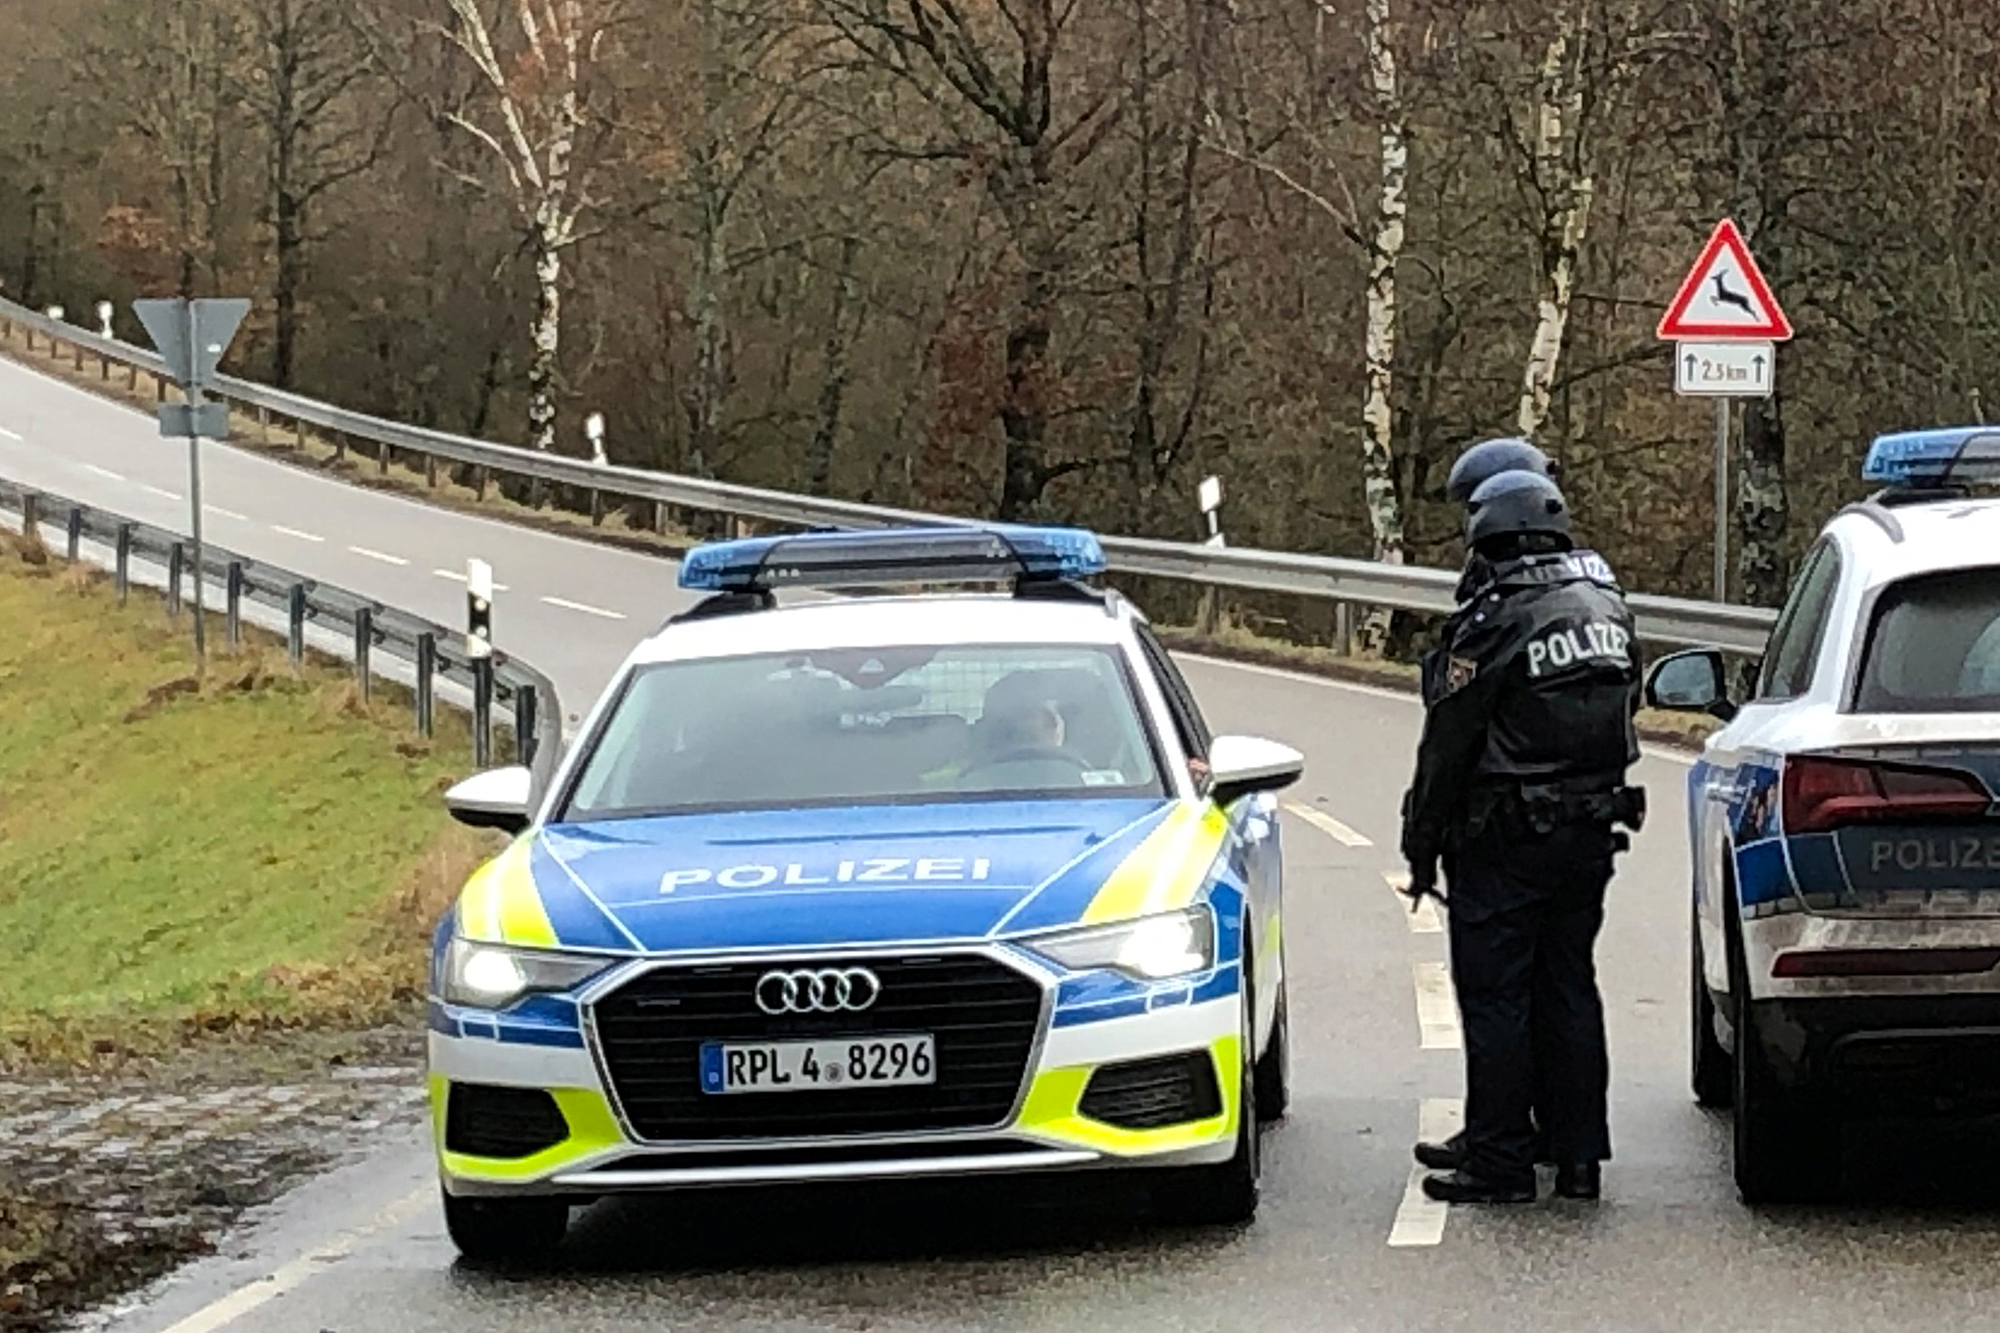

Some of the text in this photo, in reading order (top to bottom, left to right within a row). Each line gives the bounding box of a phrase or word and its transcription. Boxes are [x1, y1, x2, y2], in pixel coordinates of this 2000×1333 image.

[1726, 363, 1747, 381] km
[1527, 621, 1631, 677] POLIZE
[659, 858, 990, 894] POLIZEI
[727, 1041, 931, 1086] RPL 4 8296
